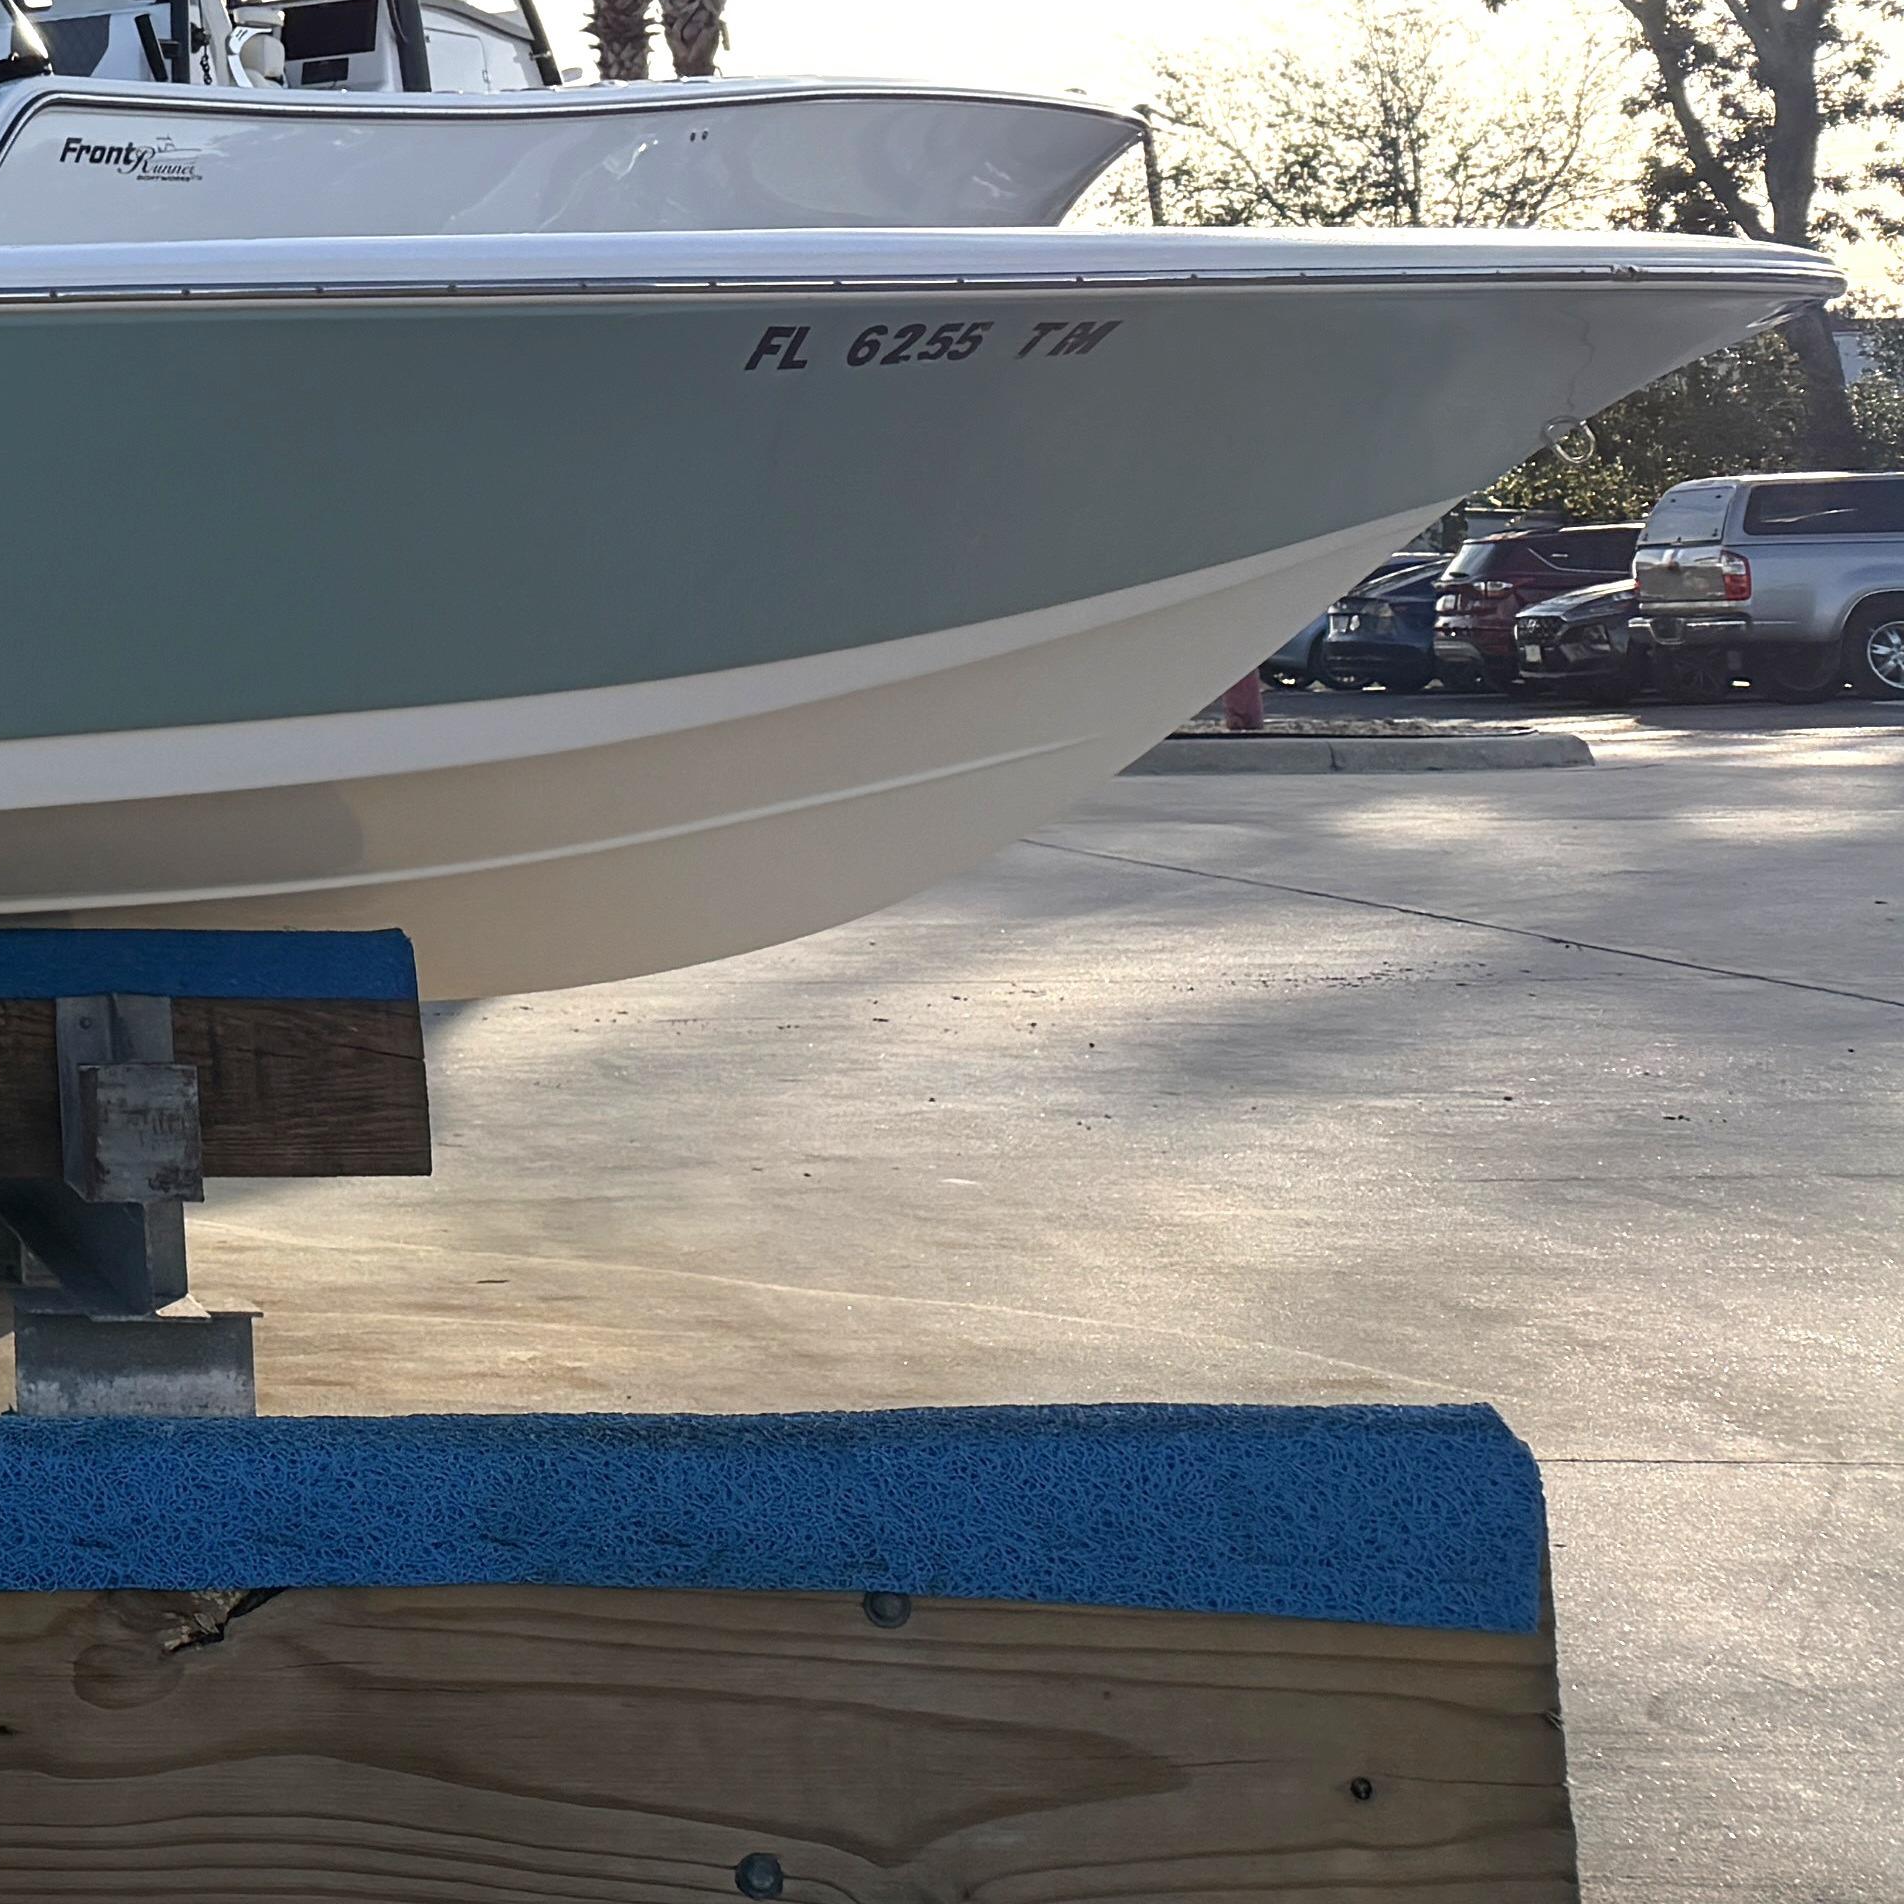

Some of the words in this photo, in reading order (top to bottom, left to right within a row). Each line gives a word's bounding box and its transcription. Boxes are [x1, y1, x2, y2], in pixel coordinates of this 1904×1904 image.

[59, 137, 136, 165] Front
[743, 326, 812, 370] FL
[846, 321, 995, 367] 6255
